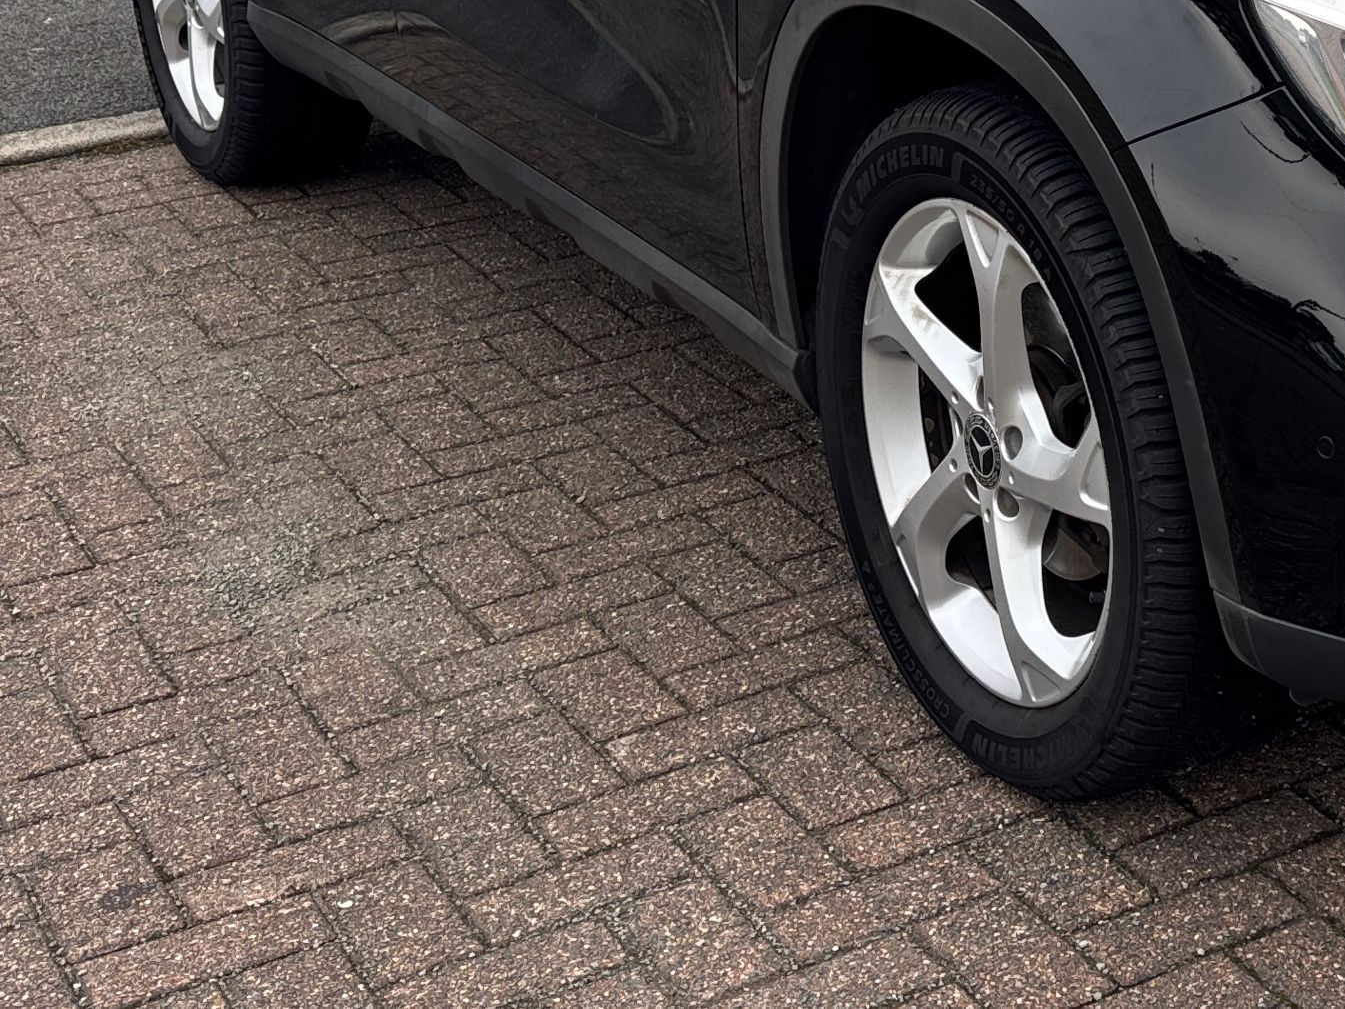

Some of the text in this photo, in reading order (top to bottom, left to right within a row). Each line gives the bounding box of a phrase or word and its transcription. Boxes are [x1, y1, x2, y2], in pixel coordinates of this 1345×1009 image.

[855, 144, 945, 204] MICHELIN
[969, 173, 1015, 223] 235/50
[1017, 223, 1027, 236] R
[871, 593, 951, 719] CROSSCLIMATE
